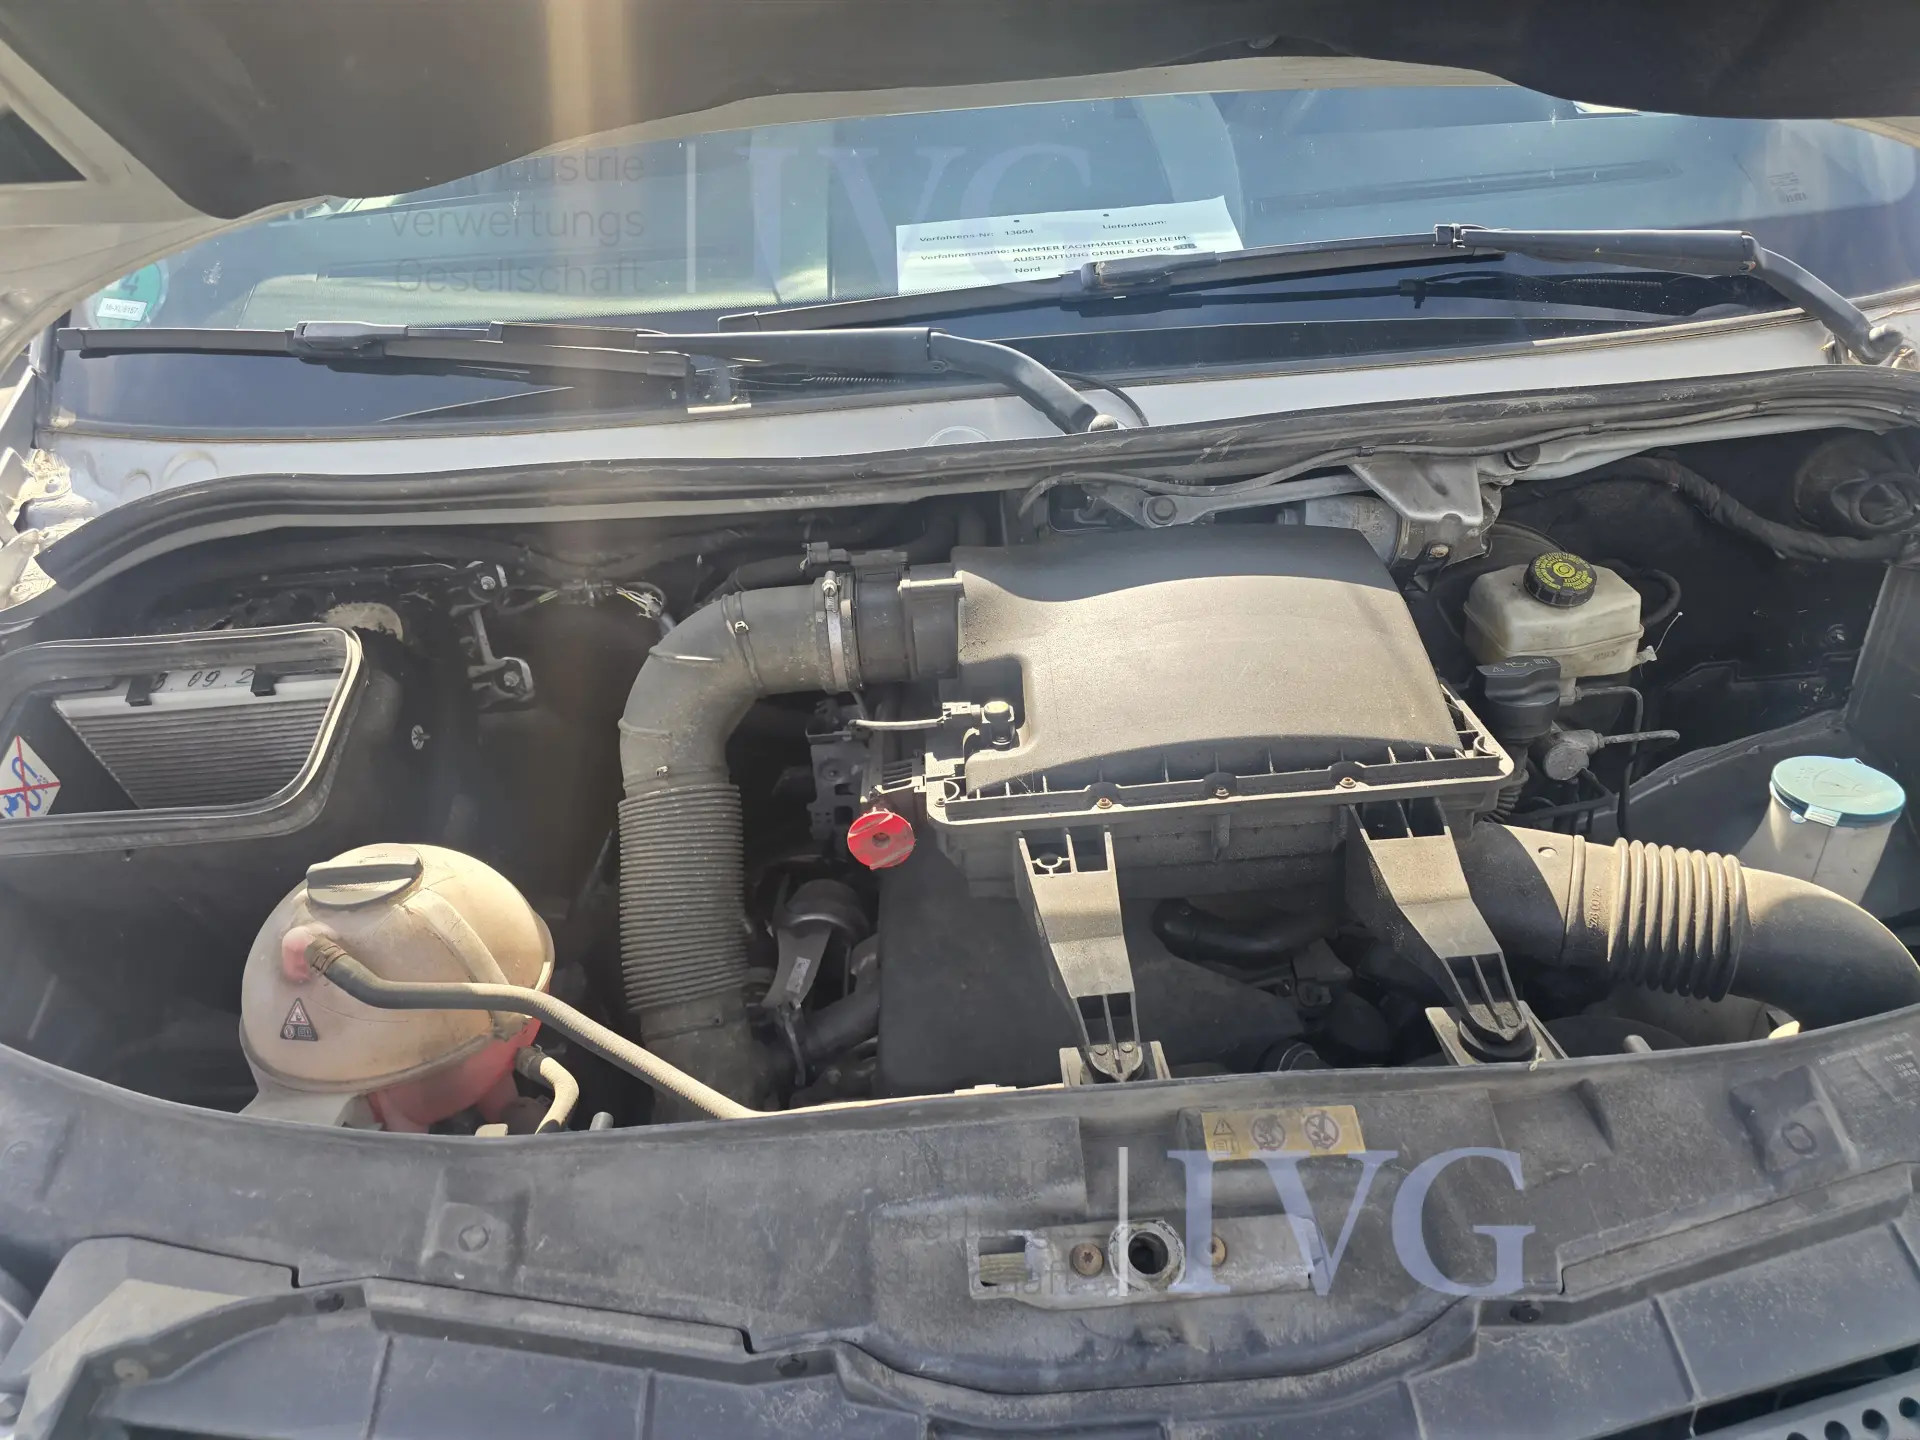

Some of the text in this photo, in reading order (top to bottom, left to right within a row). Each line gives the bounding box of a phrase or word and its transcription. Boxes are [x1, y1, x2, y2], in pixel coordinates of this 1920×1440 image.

[1102, 220, 1167, 229] Lieferdatum:
[1012, 244, 1060, 254] HAMMER
[1061, 239, 1134, 250] FACHMÄRKTE
[1135, 236, 1157, 245] FÜR
[1012, 252, 1089, 262] AUSSTATTUNG
[1091, 249, 1125, 257] GMBH
[1014, 265, 1041, 273] Nord
[121, 273, 139, 296] 4
